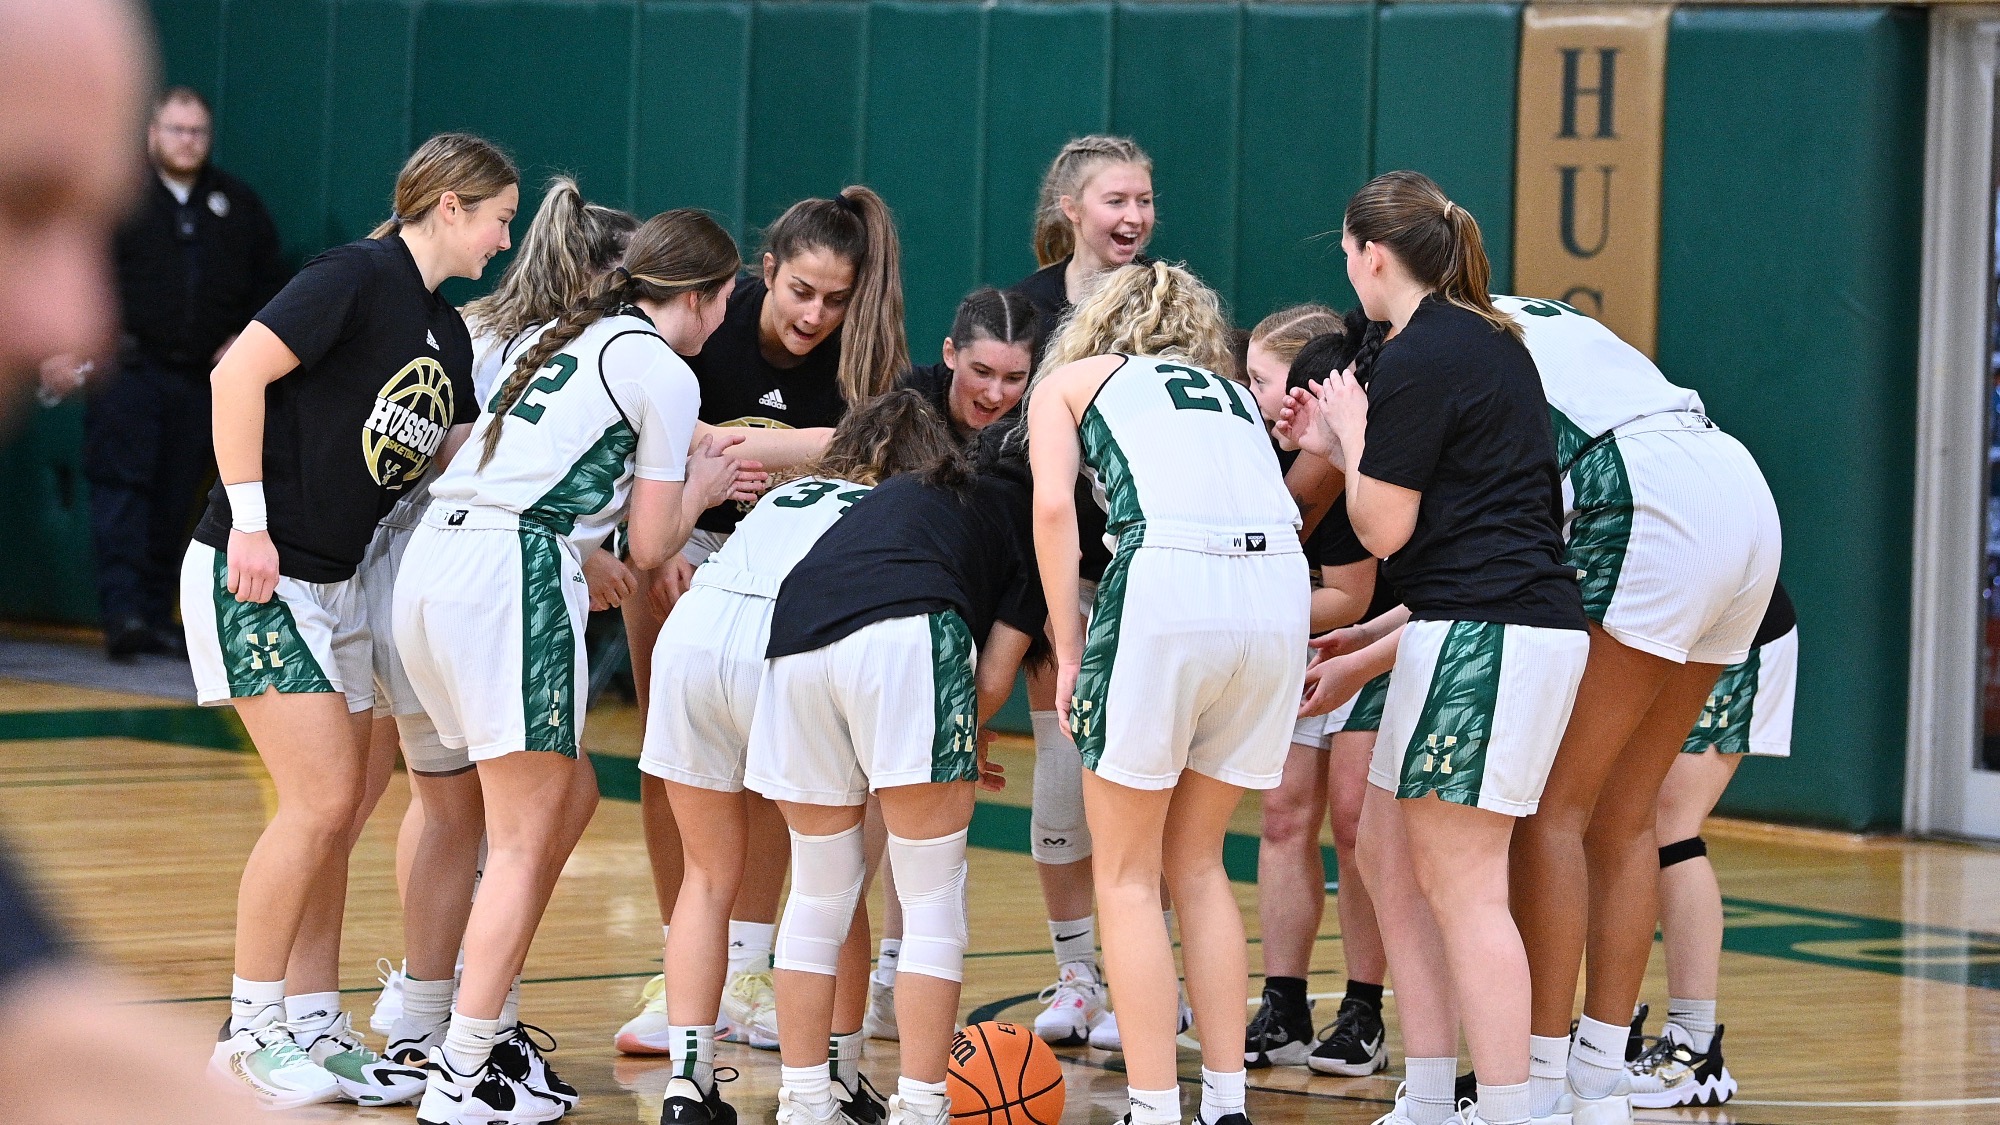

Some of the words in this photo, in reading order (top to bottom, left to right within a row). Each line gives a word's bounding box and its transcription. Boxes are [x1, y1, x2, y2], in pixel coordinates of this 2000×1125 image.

[758, 397, 787, 411] adidas
[1154, 363, 1255, 425] 21
[364, 397, 447, 458] HUSSON
